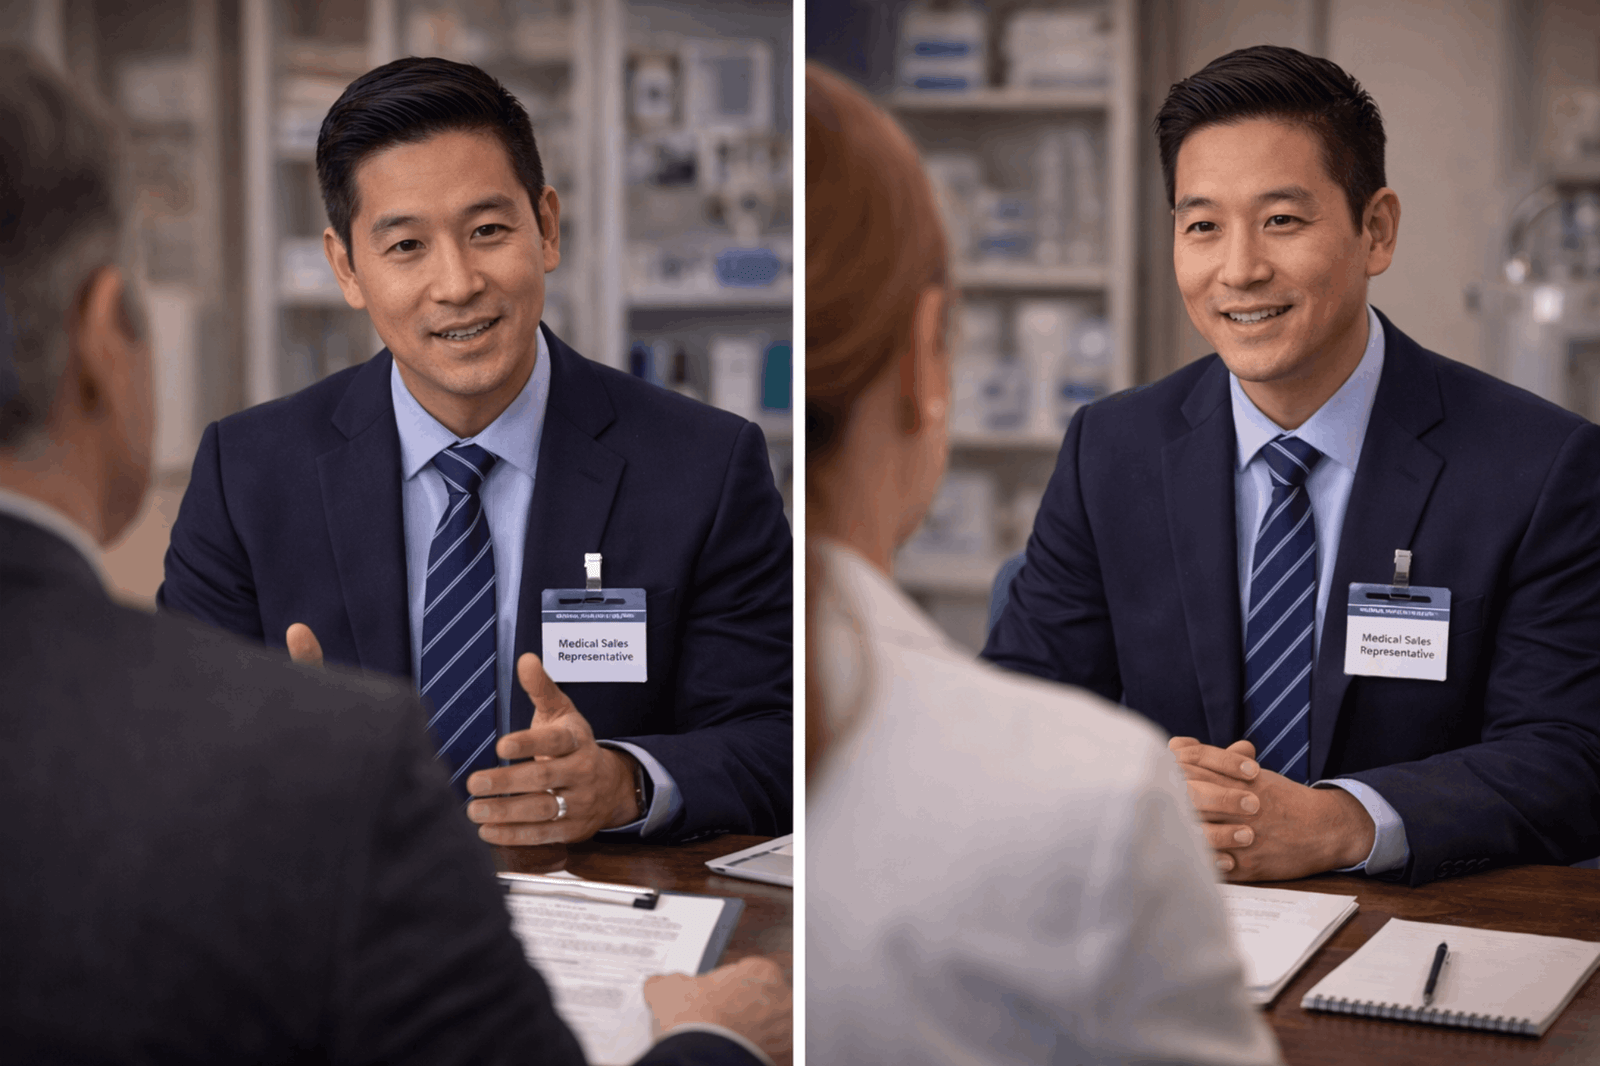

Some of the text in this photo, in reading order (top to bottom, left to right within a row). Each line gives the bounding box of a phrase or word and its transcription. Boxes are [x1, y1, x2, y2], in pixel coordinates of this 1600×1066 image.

[558, 639, 629, 648] Medical Sales
[1362, 633, 1431, 646] Medical Sales
[558, 652, 634, 663] Representative
[1360, 646, 1435, 659] Representative
